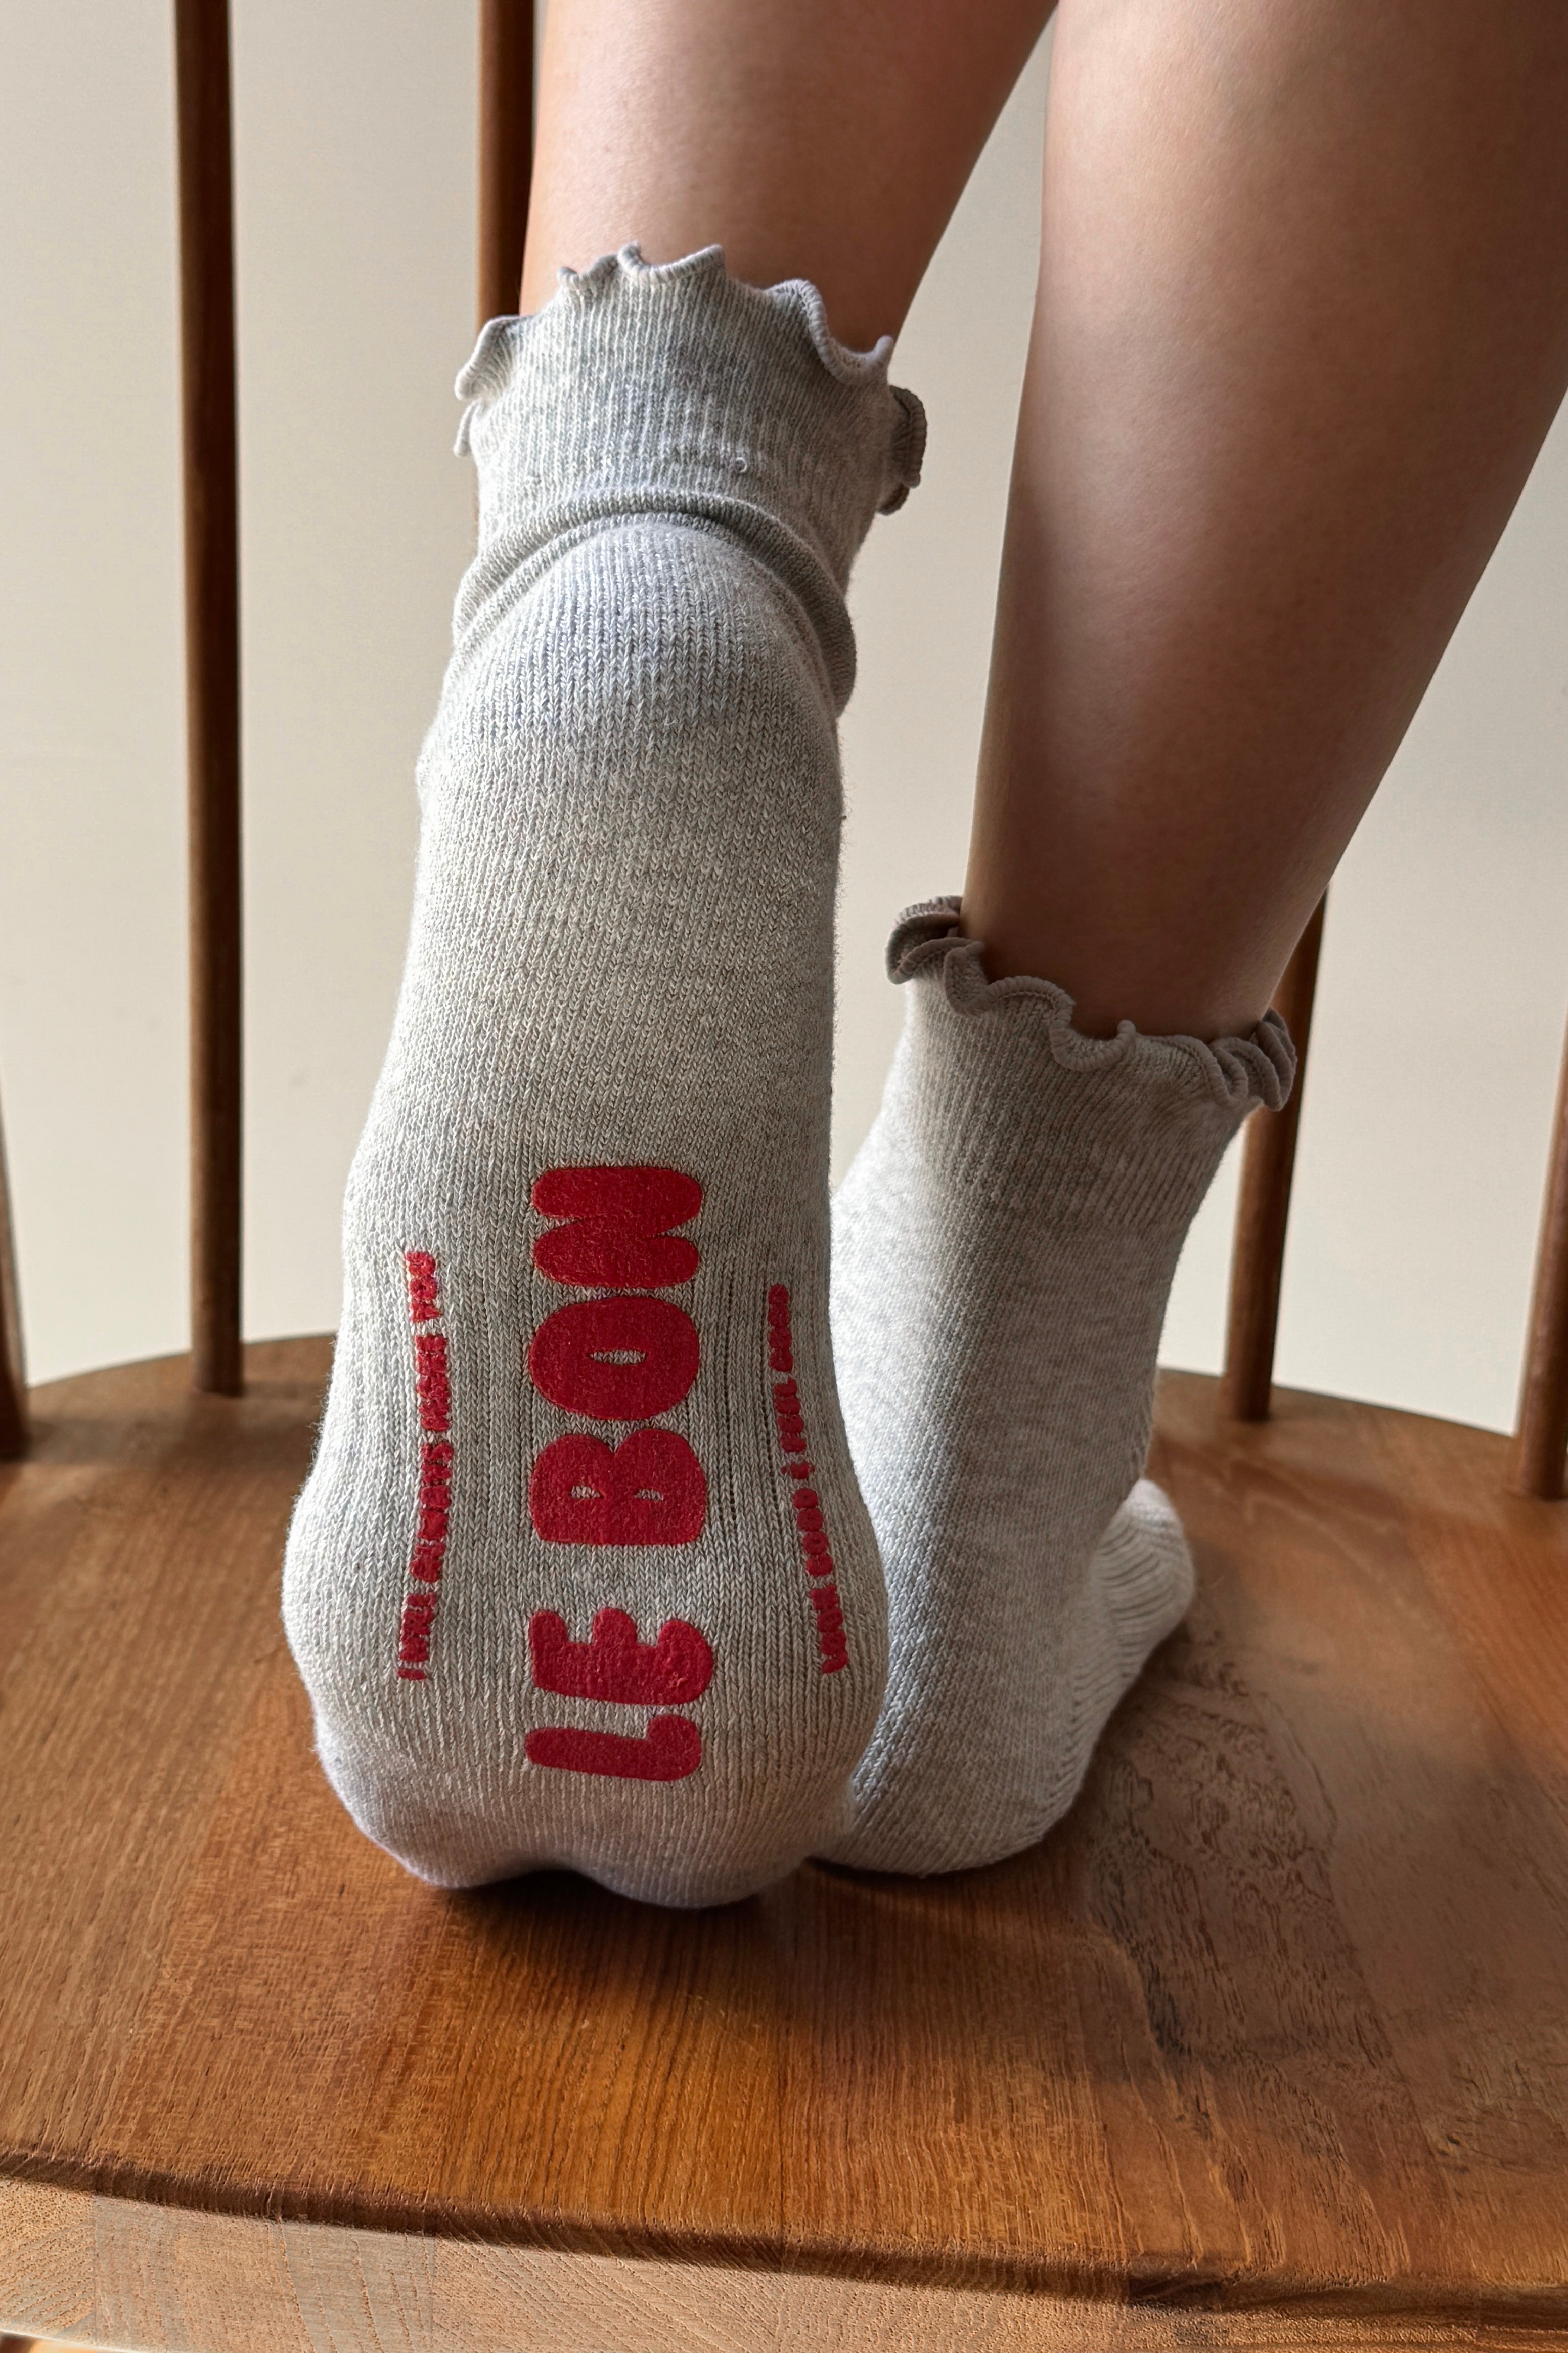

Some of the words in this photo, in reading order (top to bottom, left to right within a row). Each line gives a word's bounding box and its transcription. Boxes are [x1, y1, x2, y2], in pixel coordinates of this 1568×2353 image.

[407, 1252, 440, 1323] YOU
[769, 1286, 793, 1372] GOOD
[528, 1167, 707, 1547] BON
[775, 1380, 806, 1453] FEEL
[410, 1442, 454, 1584] ALWAYS
[793, 1489, 833, 1577] GOOD
[810, 1585, 848, 1674] LOOK
[525, 1608, 714, 1782] LE
